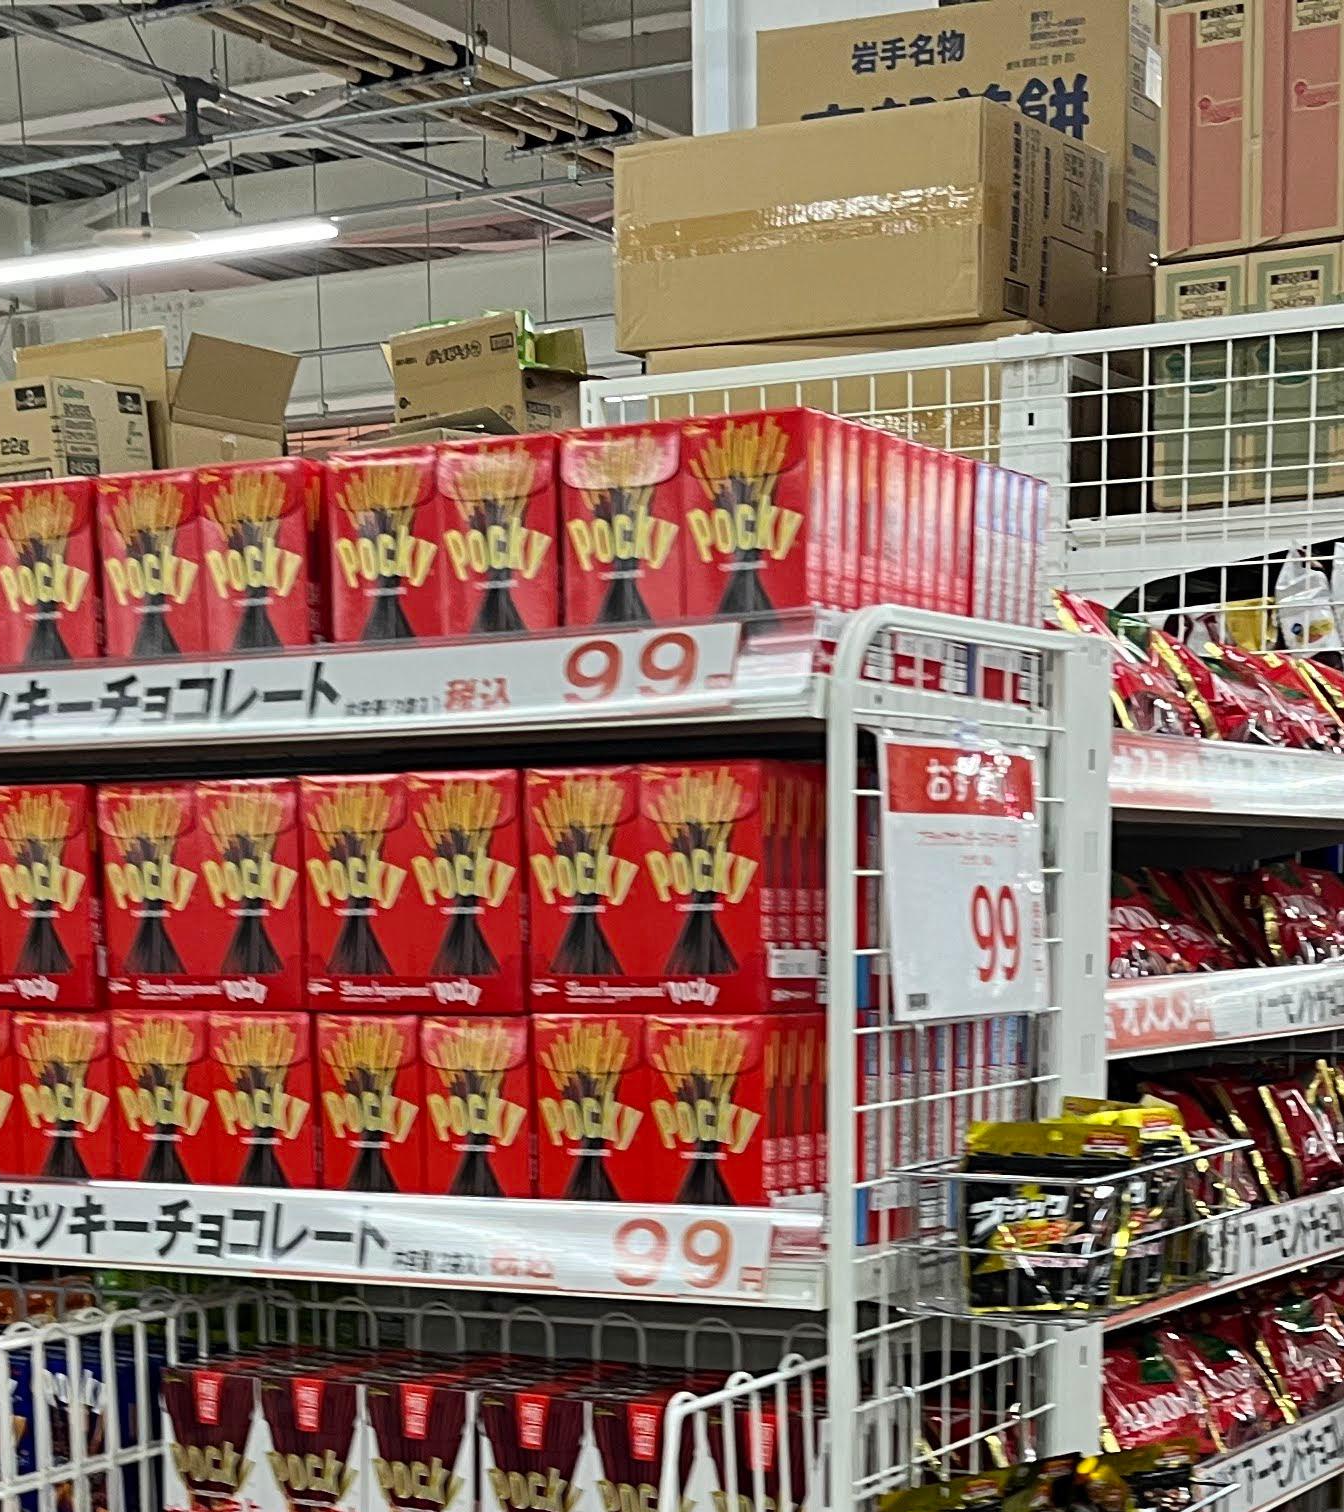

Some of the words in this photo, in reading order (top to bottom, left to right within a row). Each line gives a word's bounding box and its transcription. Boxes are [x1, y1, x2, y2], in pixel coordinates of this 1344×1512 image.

[851, 29, 965, 75] 岩手名物
[336, 531, 437, 587] POCKY
[444, 521, 551, 579] POCKY
[566, 507, 678, 568] POCKY
[686, 496, 803, 562] POCKY
[109, 548, 195, 603] POCKY
[205, 539, 301, 598] POCKY
[565, 632, 701, 703] 99
[970, 884, 1020, 983] 99
[613, 1219, 734, 1290] 99
